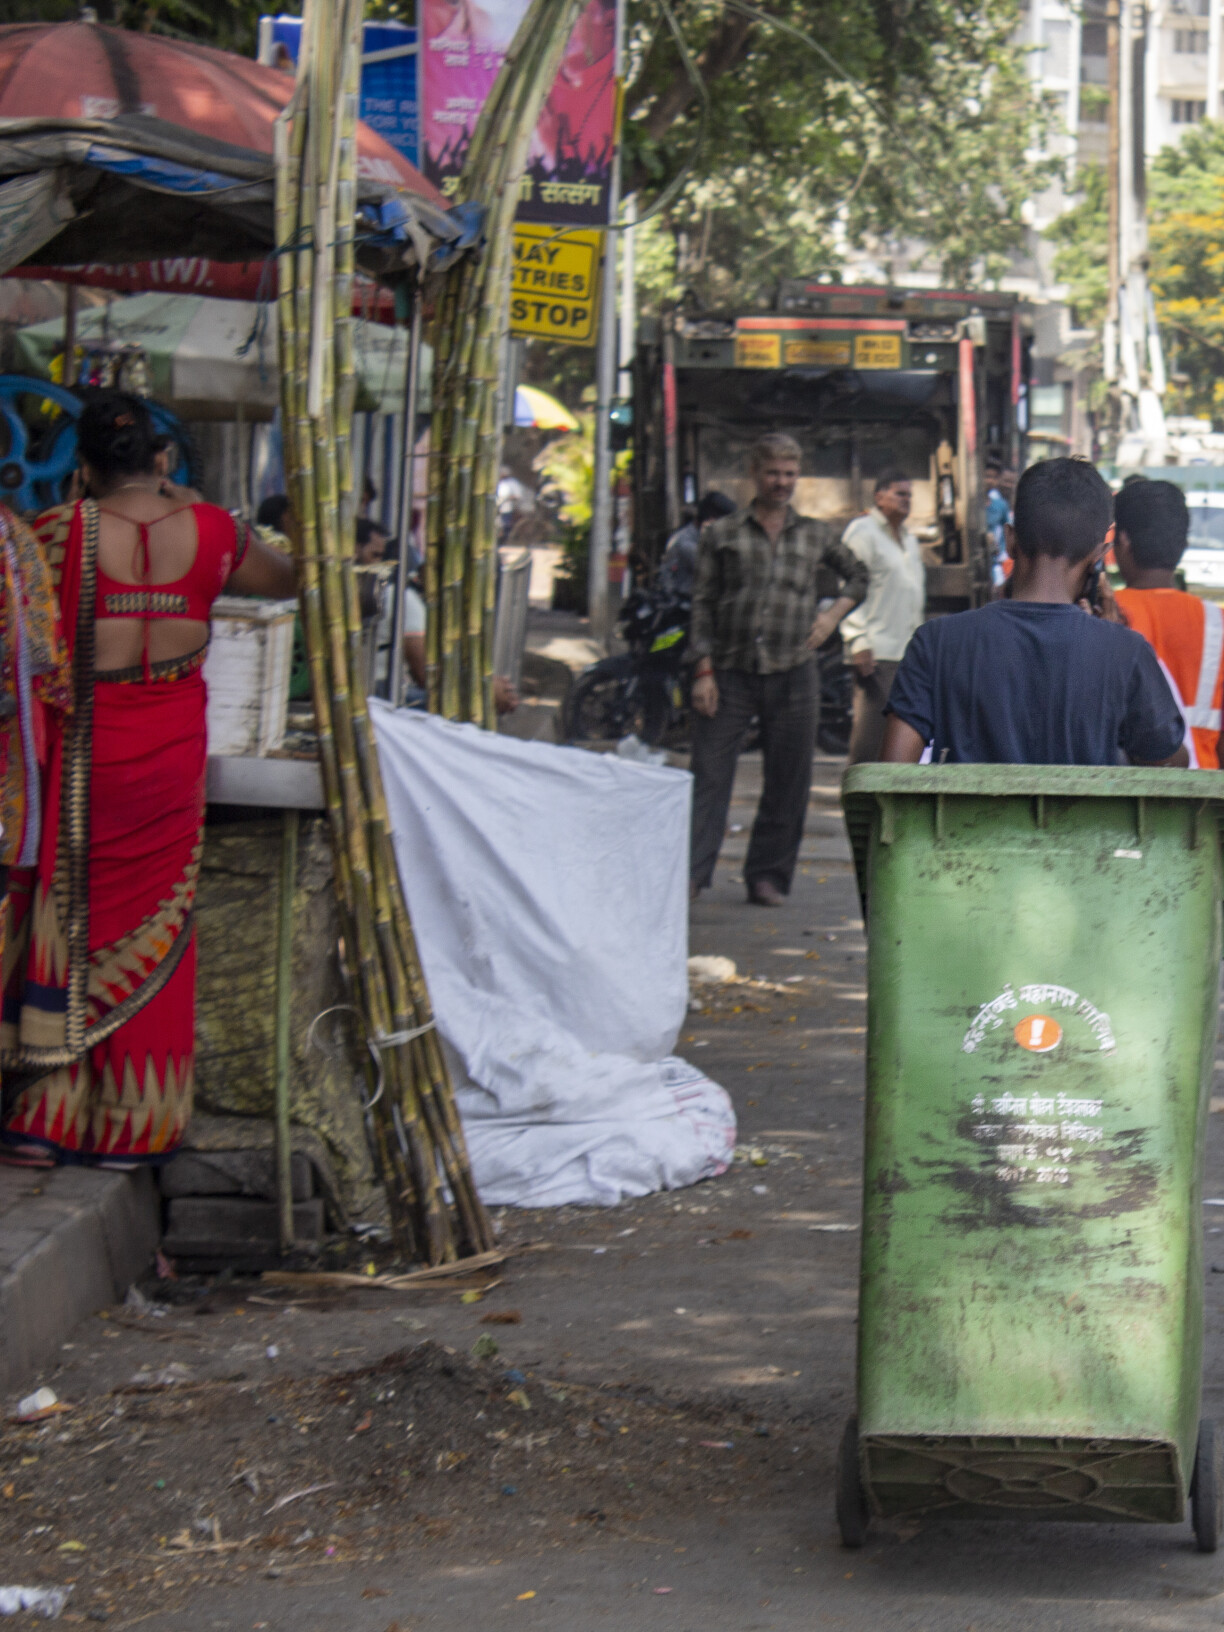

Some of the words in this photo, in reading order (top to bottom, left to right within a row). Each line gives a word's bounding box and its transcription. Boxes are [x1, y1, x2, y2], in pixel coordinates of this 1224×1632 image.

[539, 178, 602, 206] सत्संग
[511, 299, 588, 327] STOP
[1019, 983, 1079, 1007] महानगर
